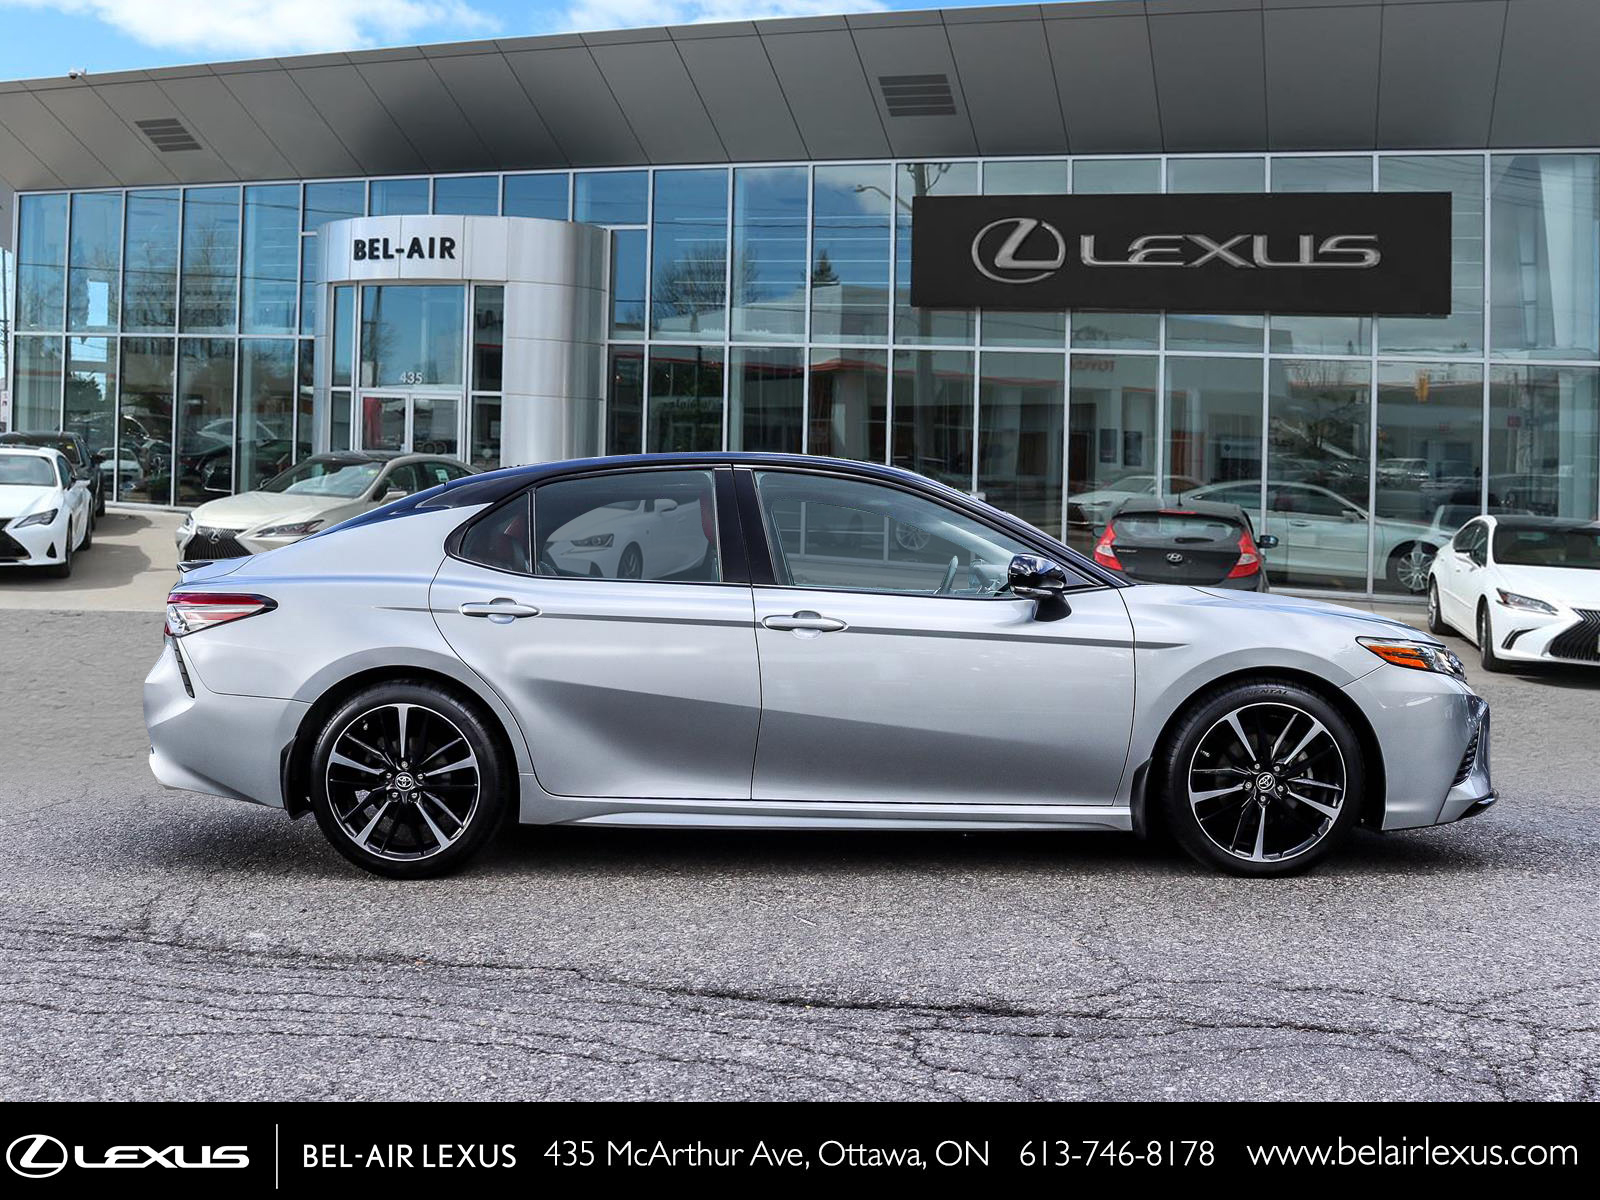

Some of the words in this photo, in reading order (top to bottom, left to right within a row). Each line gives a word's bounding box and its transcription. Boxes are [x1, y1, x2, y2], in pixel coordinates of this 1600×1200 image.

[353, 236, 456, 261] BEL-AIR
[1080, 234, 1382, 268] LEXUS
[400, 371, 424, 384] 435
